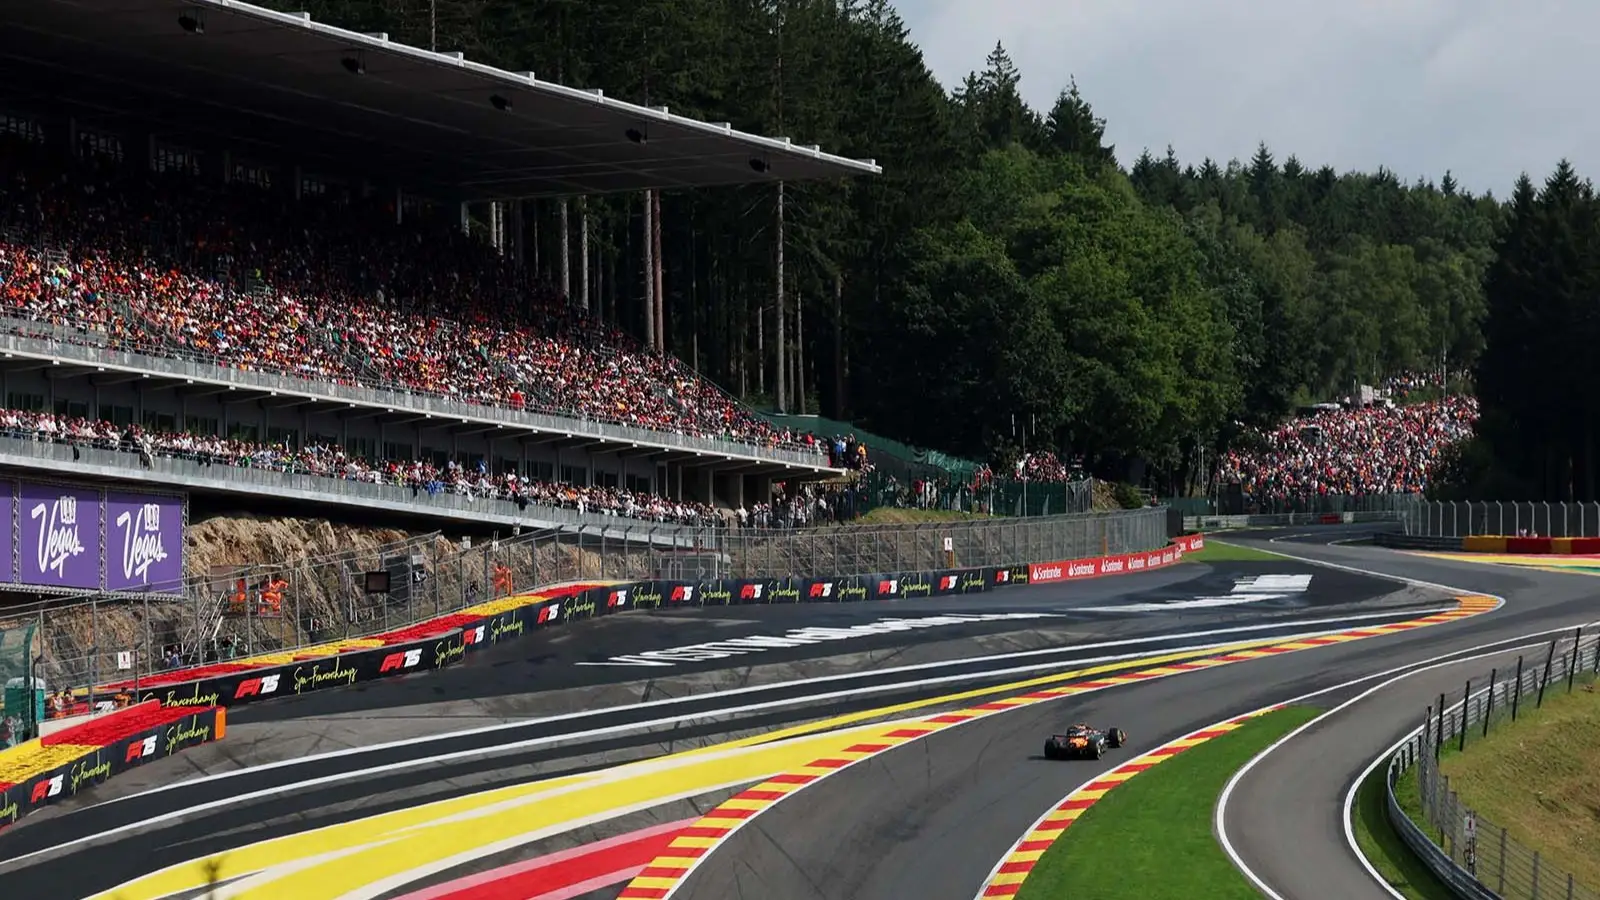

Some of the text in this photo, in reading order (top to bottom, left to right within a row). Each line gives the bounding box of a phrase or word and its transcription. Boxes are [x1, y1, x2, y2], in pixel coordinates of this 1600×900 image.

[31, 499, 85, 579] Vegas
[117, 507, 168, 584] Vegas
[1038, 565, 1061, 580] Santander
[1073, 562, 1095, 576] Santander
